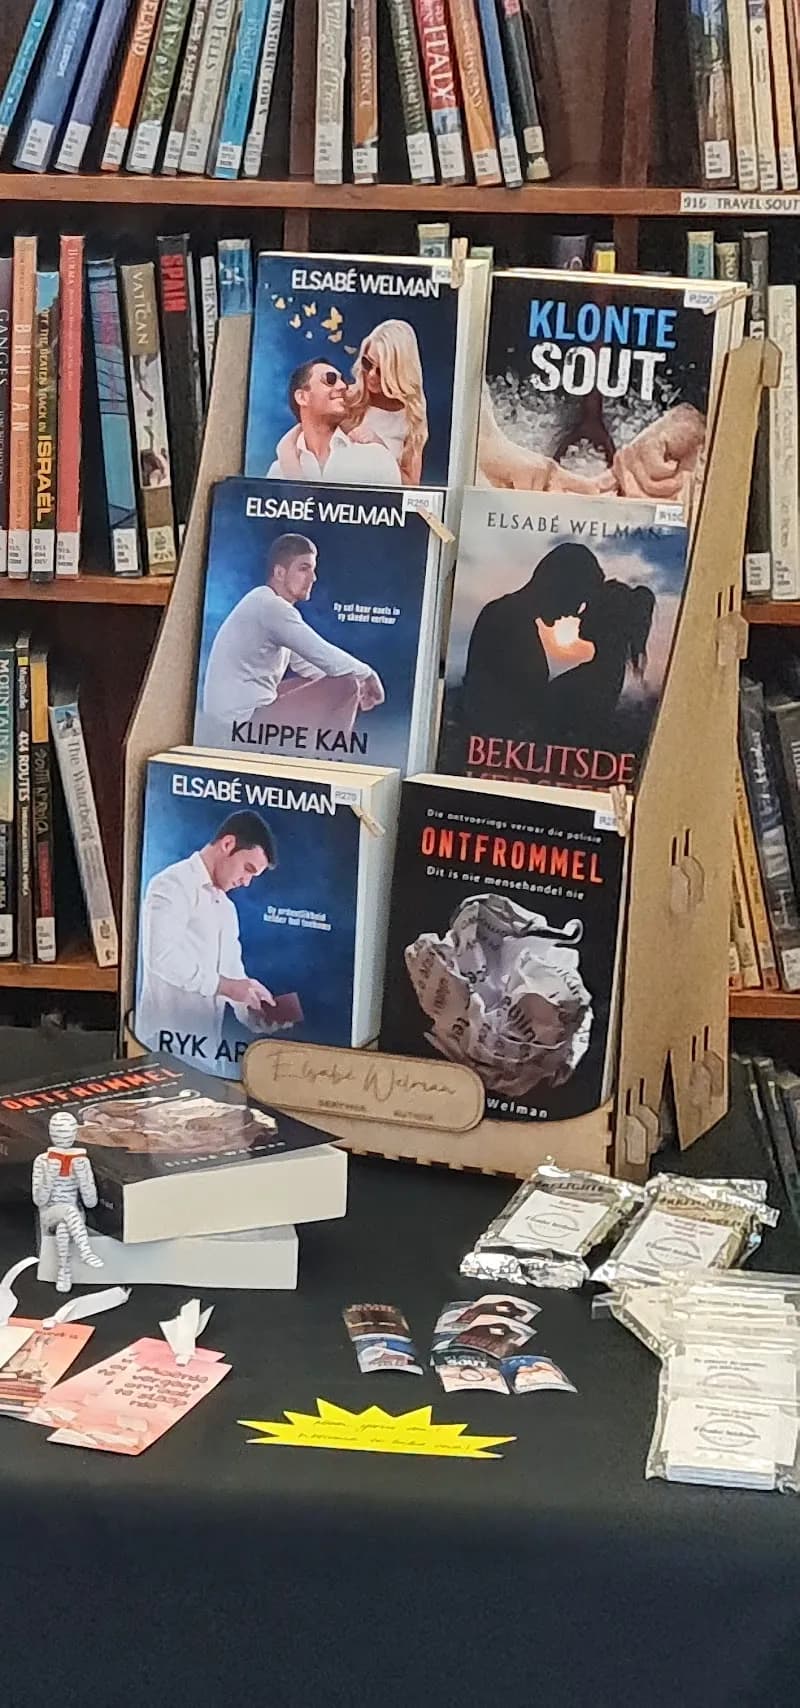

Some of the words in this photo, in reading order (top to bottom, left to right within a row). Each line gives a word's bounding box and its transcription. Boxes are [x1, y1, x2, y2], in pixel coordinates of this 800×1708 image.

[423, 24, 455, 102] ITALY
[716, 197, 765, 210] TRAVEL
[160, 255, 187, 312] SPAIN
[292, 268, 356, 293] ELSABÉ
[360, 274, 439, 298] WELMAN
[131, 272, 149, 345] VATICAN
[528, 300, 678, 349] KLONTE
[12, 324, 31, 432] BHUTAN
[530, 342, 666, 401] SOUT
[246, 497, 315, 521] ELSABÉ
[318, 503, 405, 527] WELMAN
[487, 512, 560, 533] ELSABÉ
[67, 742, 82, 765] The
[231, 720, 308, 749] KLIPPE
[316, 728, 368, 754] KAN
[18, 755, 30, 802] ROUTES
[467, 736, 636, 783] BEKLITSDE
[72, 770, 94, 841] Waterberg
[172, 774, 242, 803] ELSABÉ
[245, 784, 336, 816] WELMAN
[427, 808, 443, 819] Die
[548, 828, 563, 838] die
[421, 826, 603, 884] ONTFROMMEL
[426, 866, 444, 877] Dit
[447, 870, 458, 880] is
[462, 872, 480, 883] nie
[484, 876, 563, 897] mensehandel
[566, 889, 584, 900] nie
[159, 1030, 208, 1058] RYK
[0, 1068, 184, 1110] ONTFROMMEL
[486, 1098, 548, 1119] Welman
